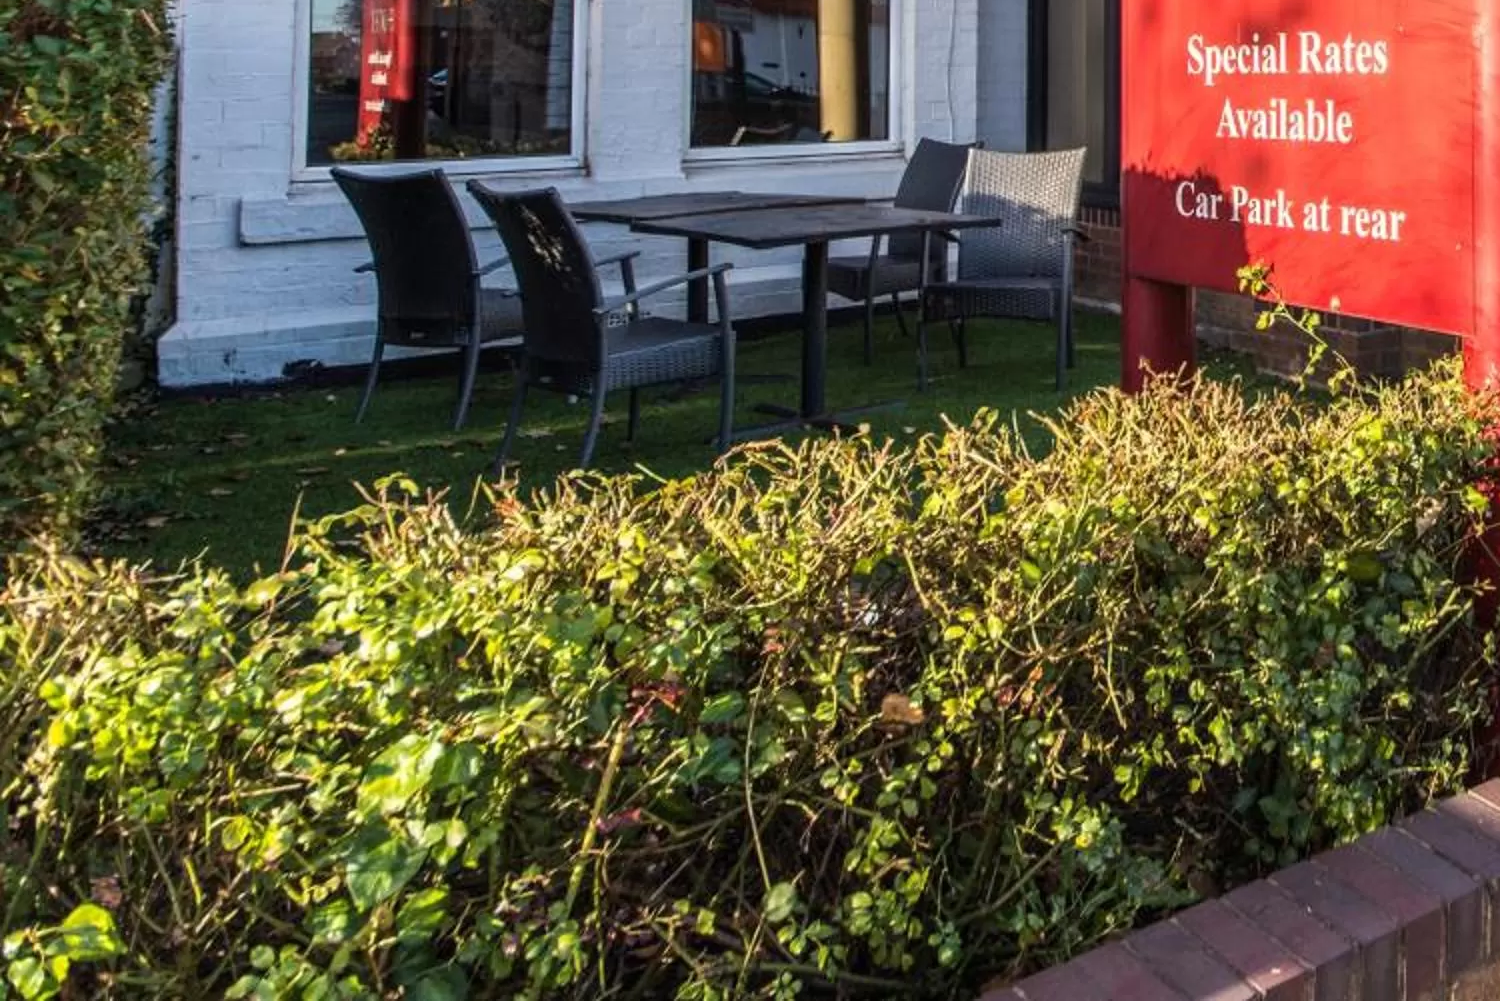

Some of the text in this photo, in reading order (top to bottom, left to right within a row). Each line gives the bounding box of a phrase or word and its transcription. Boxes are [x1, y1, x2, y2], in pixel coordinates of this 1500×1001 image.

[1187, 31, 1389, 84] Special Rates
[1216, 98, 1353, 144] Available
[1176, 181, 1406, 242] Car Park at rear
